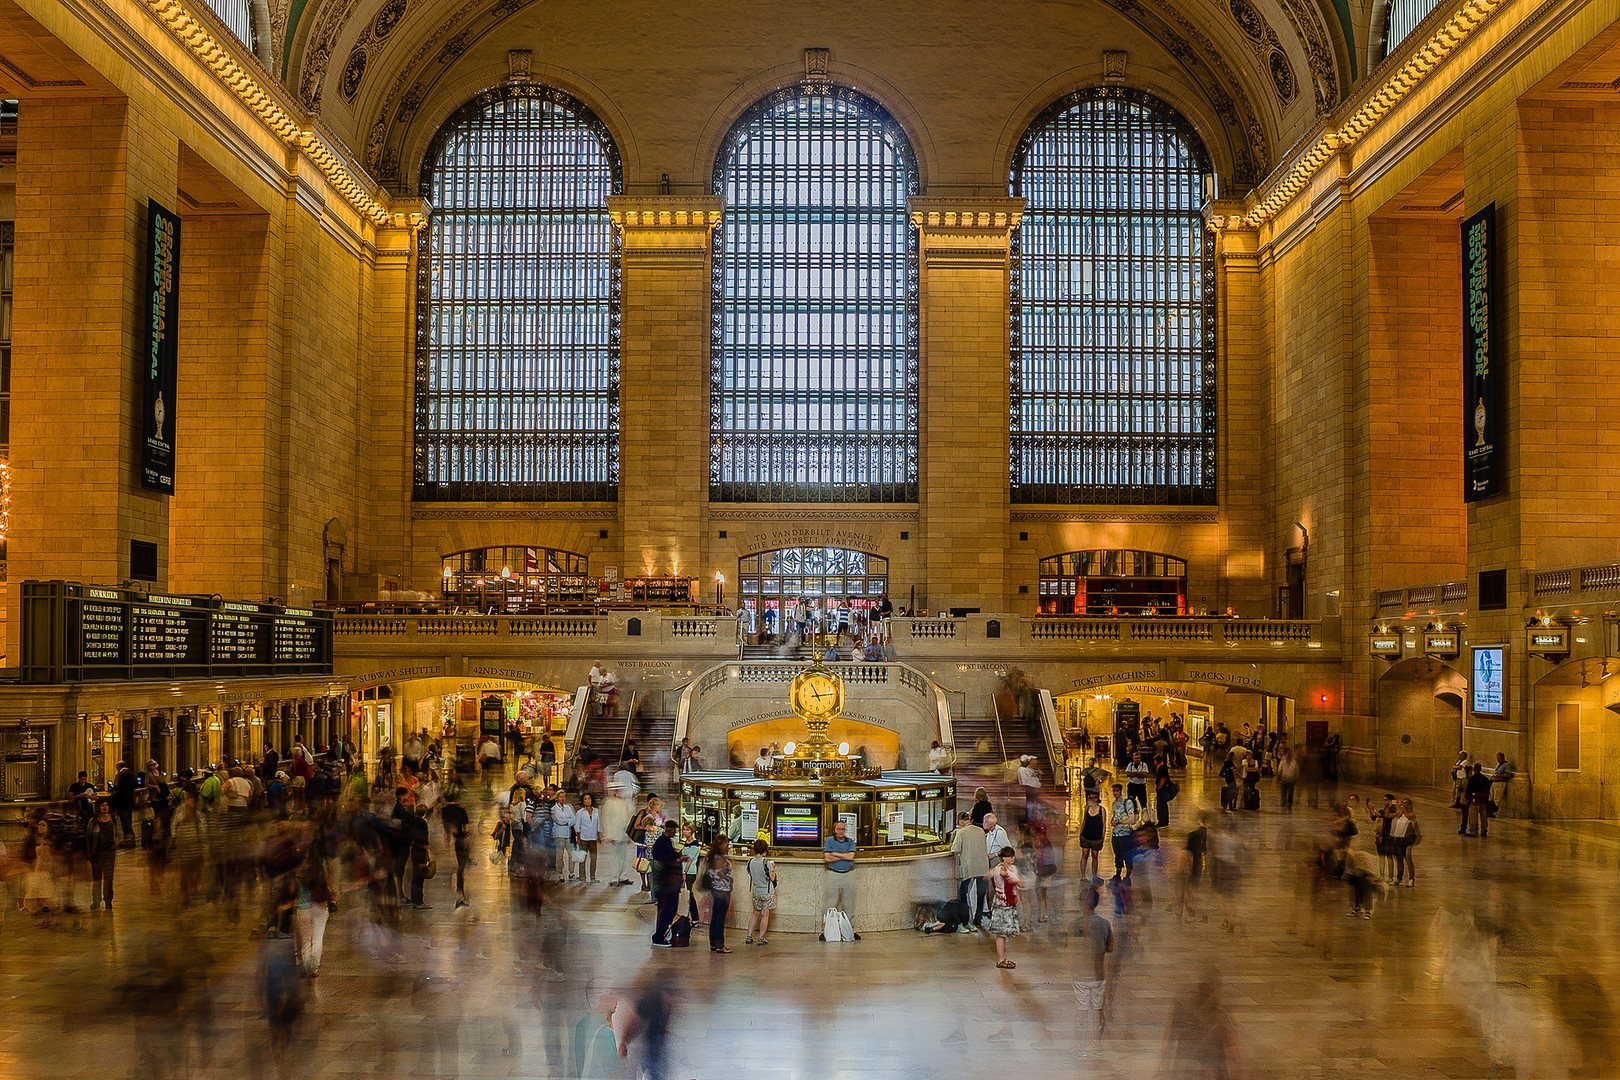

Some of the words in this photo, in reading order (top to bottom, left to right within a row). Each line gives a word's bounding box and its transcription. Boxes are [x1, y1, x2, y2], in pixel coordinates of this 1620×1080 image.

[1474, 222, 1482, 304] MOVING
[158, 217, 168, 342] CENTENNIAL
[1475, 307, 1483, 334] US
[151, 290, 160, 380] CENTRAL
[1476, 337, 1484, 376] FOR
[754, 533, 767, 542] TO
[772, 528, 830, 538] VANDERBILT
[836, 530, 874, 542] AVENUE
[746, 542, 766, 552] THE
[771, 536, 820, 546] CAMPBELL
[824, 538, 880, 552] APARTMENT
[359, 669, 396, 682] SUBWAY
[400, 666, 441, 676] SHUTTLE
[473, 666, 498, 674] 42ND
[500, 668, 534, 680] STREET
[1072, 675, 1104, 688] TICKET
[1107, 670, 1156, 682] MACHINES
[1188, 670, 1225, 680] TRACKS
[1226, 674, 1235, 682] 31
[1237, 676, 1250, 684] TO
[1252, 678, 1262, 687] 42
[460, 682, 493, 690] SUBWAY
[1127, 684, 1162, 694] WAITING
[1166, 688, 1189, 698] ROOM
[731, 716, 756, 728] DINING
[802, 760, 846, 769] Information
